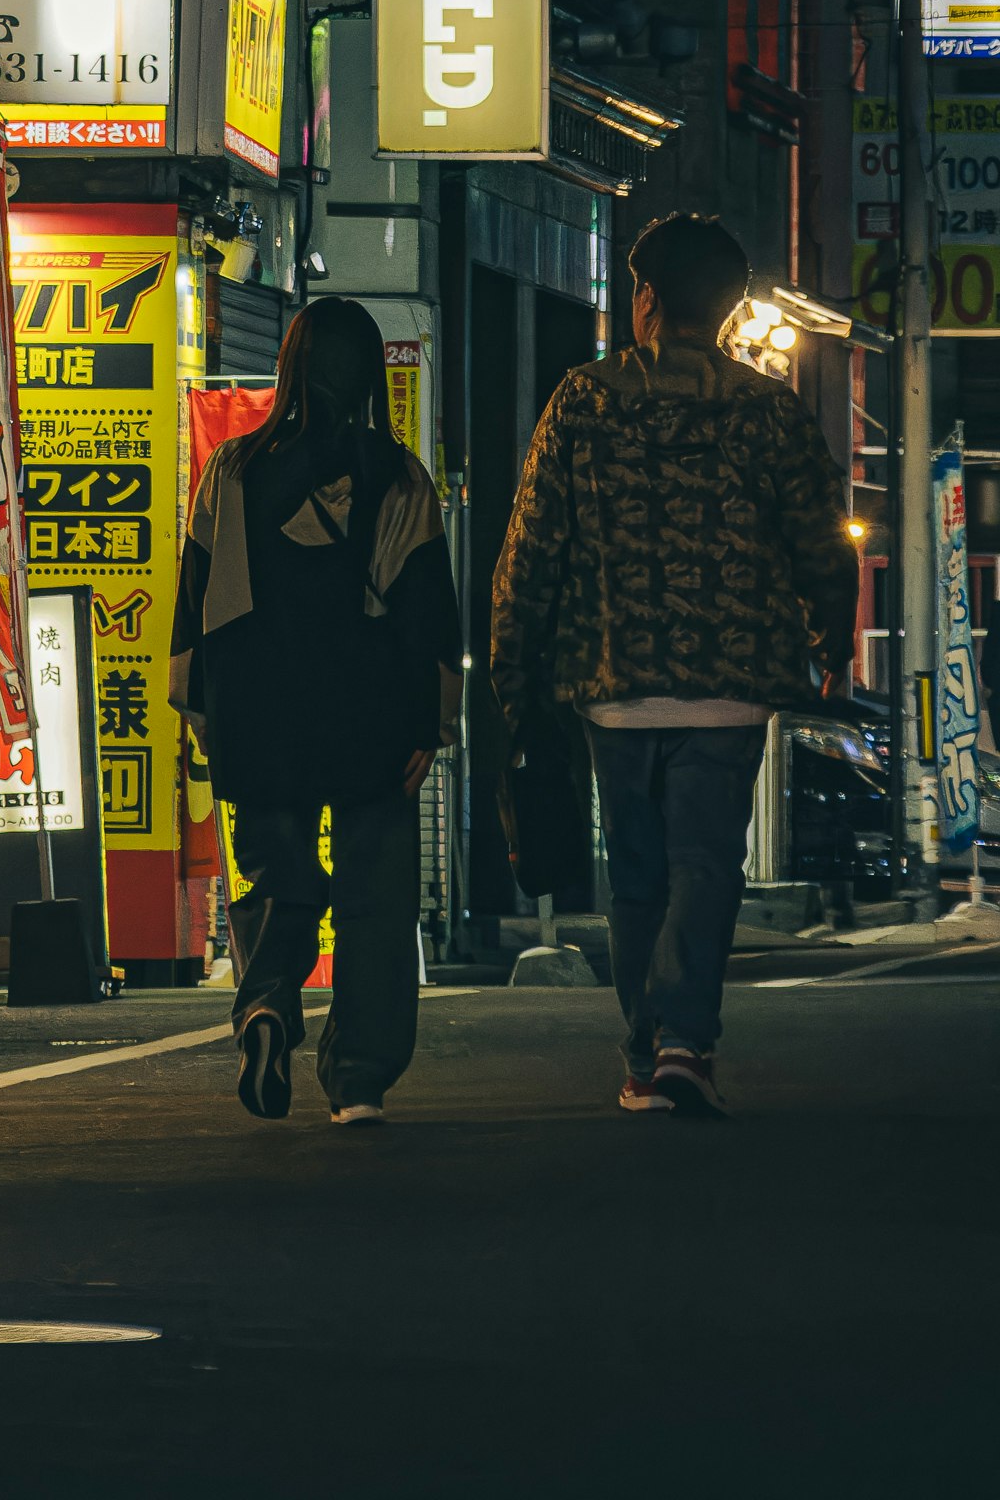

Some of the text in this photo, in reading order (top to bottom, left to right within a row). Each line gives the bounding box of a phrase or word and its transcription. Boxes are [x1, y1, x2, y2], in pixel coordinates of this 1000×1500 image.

[25, 255, 92, 268] EXPRESS
[20, 420, 150, 439] 専用ルーム内で
[20, 439, 153, 459] 安心の品質管理
[27, 470, 141, 507] ワイン
[29, 519, 141, 561] 日本酒
[36, 626, 62, 687] 焼肉
